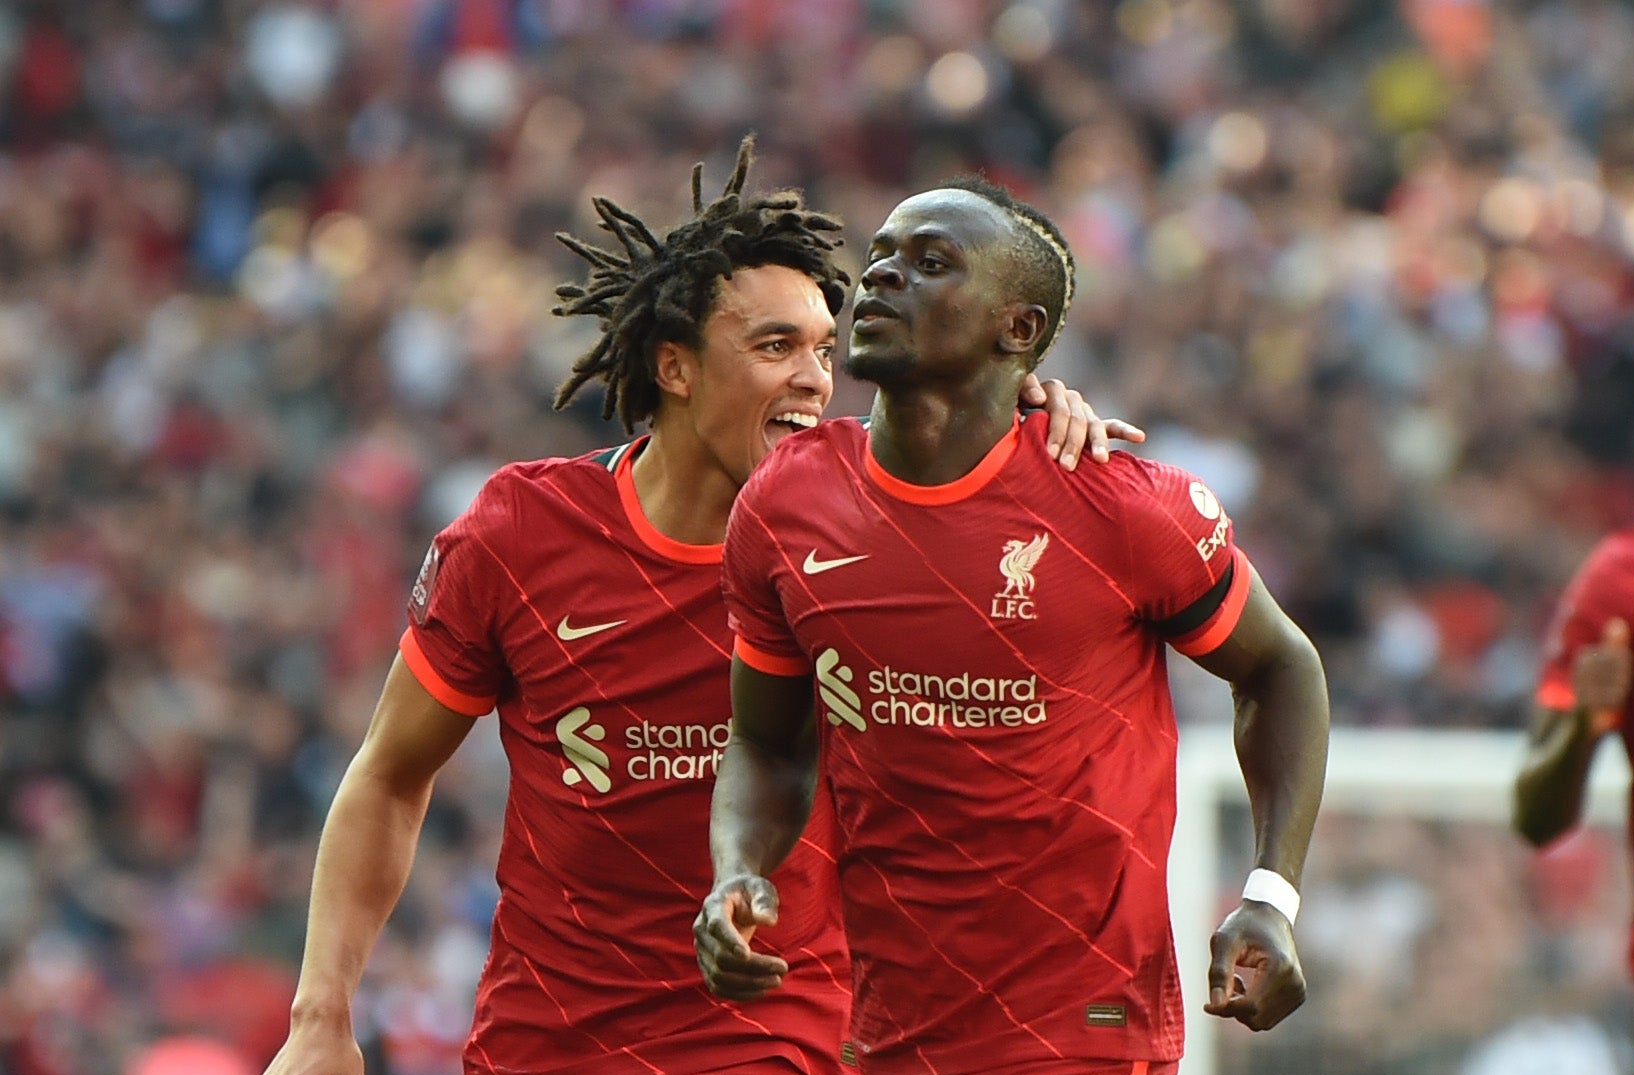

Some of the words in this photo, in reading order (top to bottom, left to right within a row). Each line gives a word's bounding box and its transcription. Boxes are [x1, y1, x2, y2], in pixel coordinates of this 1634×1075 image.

[868, 665, 1037, 702] standard
[871, 695, 1047, 728] chartered
[625, 717, 733, 749] stand
